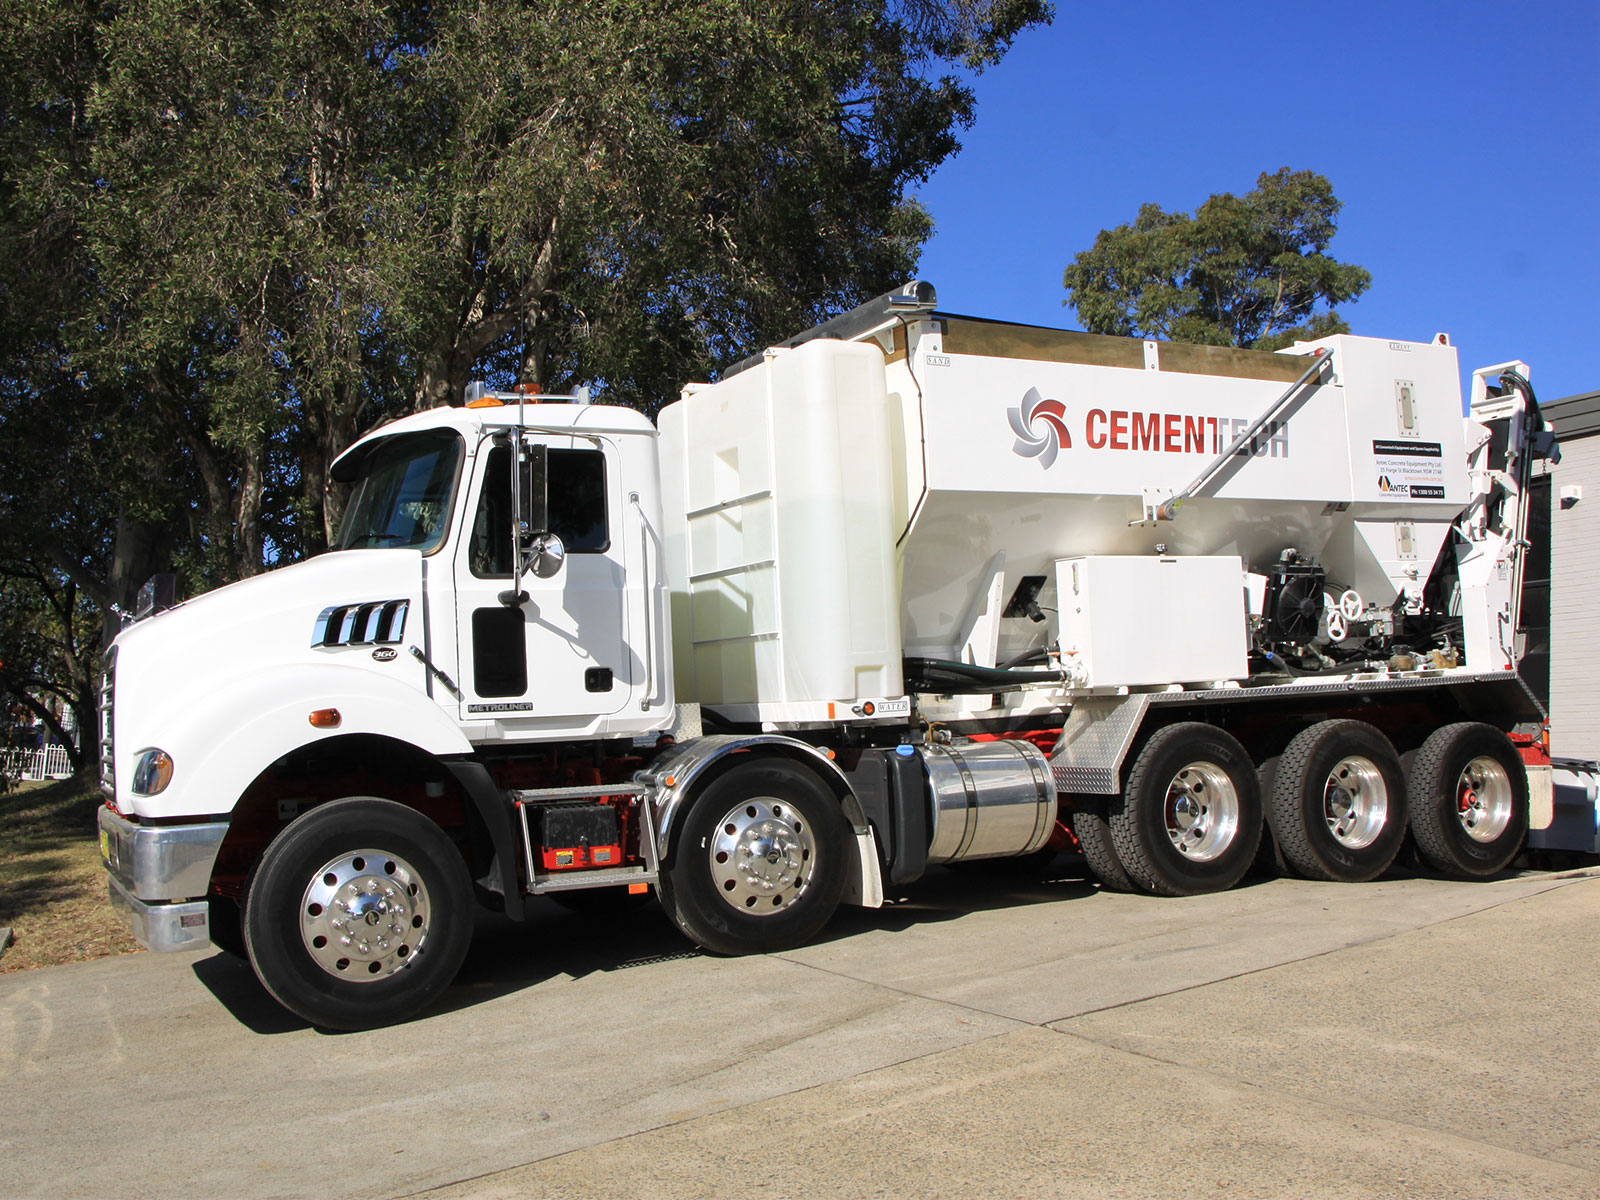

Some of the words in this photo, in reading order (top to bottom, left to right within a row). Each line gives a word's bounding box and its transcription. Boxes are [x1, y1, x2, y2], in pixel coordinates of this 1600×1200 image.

[927, 357, 950, 365] SAND
[374, 650, 397, 658] 360
[468, 703, 532, 712] METROLINER
[879, 703, 907, 711] WATER
